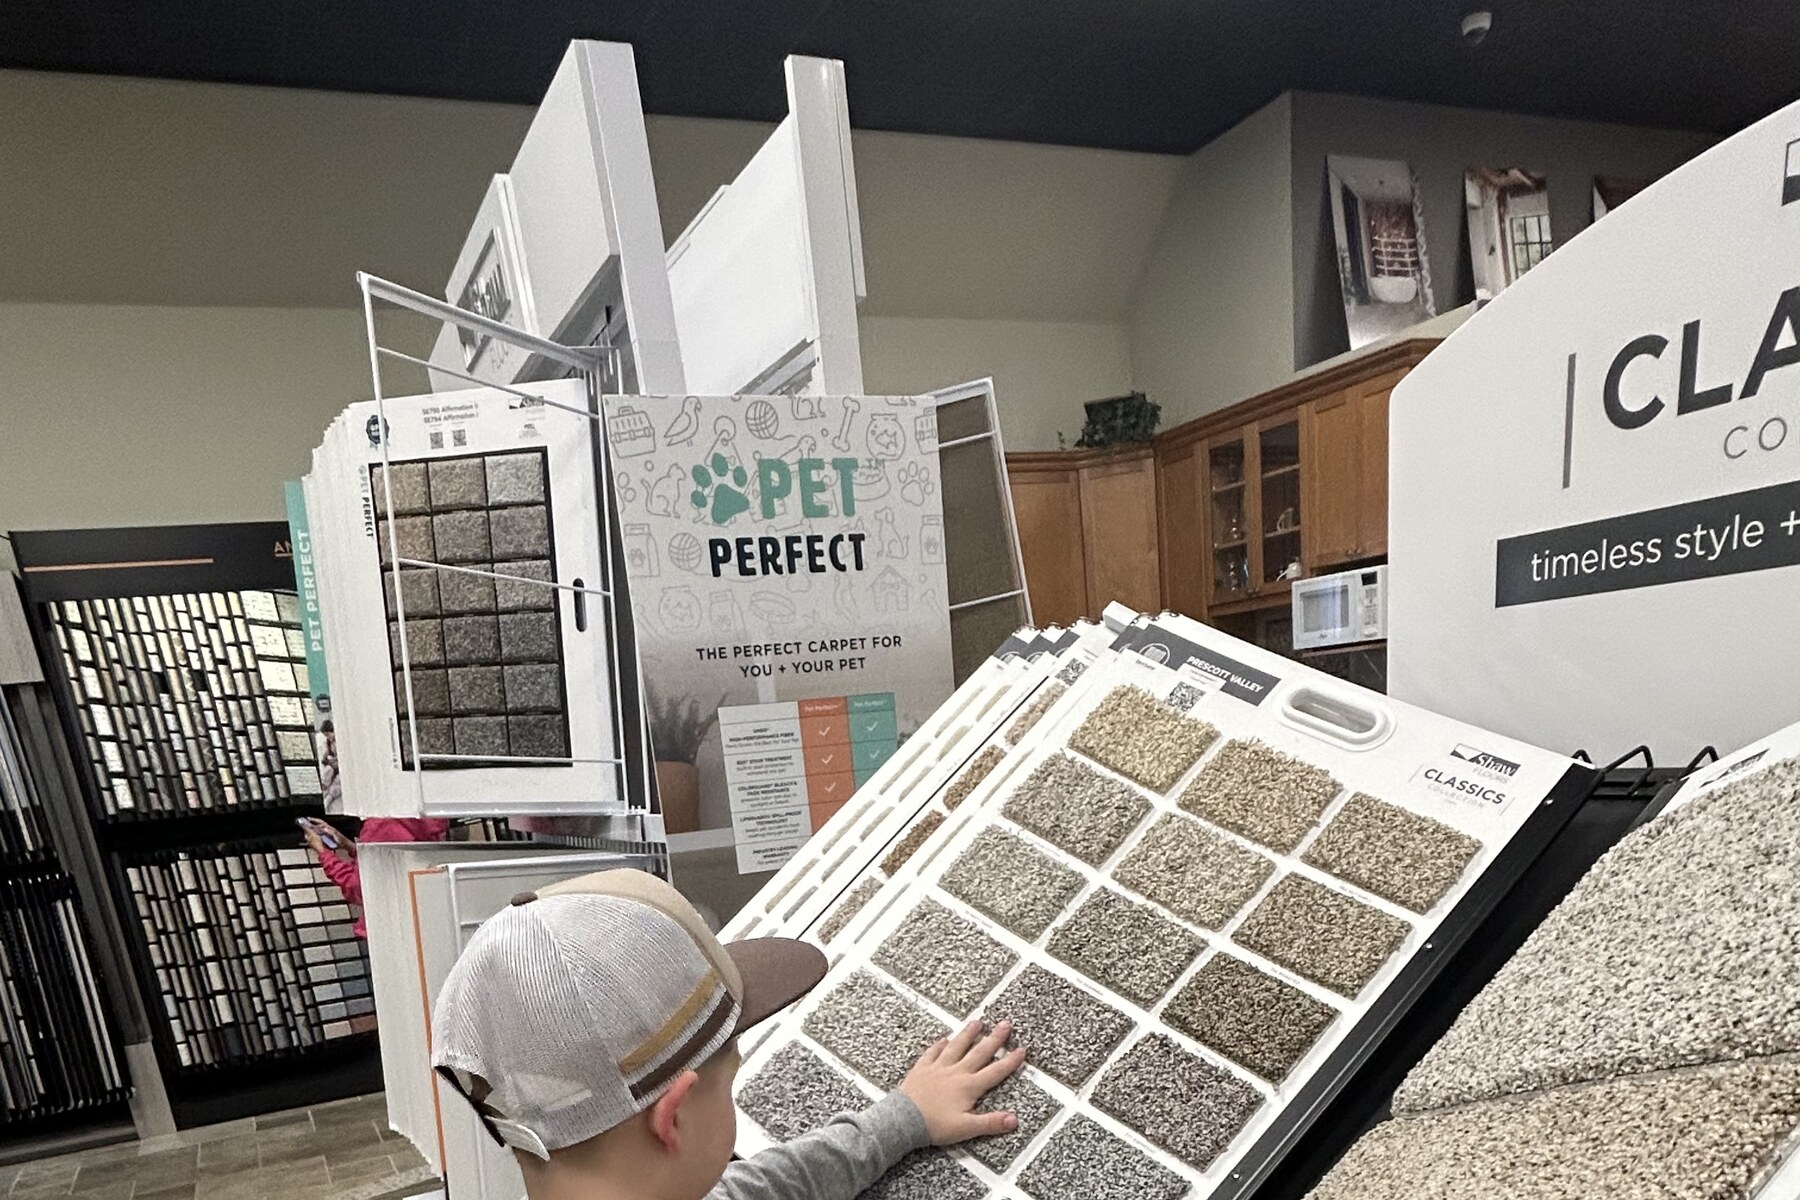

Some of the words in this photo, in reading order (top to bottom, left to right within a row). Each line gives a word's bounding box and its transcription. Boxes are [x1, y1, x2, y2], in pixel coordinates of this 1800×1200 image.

[758, 457, 858, 519] PET
[362, 497, 374, 537] PERFECT
[708, 533, 865, 577] PERFECT
[1531, 535, 1662, 582] timeless
[1674, 514, 1765, 562] style
[297, 529, 318, 612] PERFECT
[308, 617, 323, 652] PET
[696, 647, 727, 660] THE
[733, 642, 802, 658] PERFECT
[808, 637, 866, 653] CARPET
[872, 635, 902, 648] FOR
[740, 664, 772, 678] YOU
[792, 660, 834, 673] YOUR
[839, 657, 866, 670] PET
[1186, 655, 1231, 680] PRESCOTT
[1229, 673, 1265, 693] VALLEY
[1476, 754, 1517, 777] Shaw
[1424, 768, 1506, 804] CLASSICS
